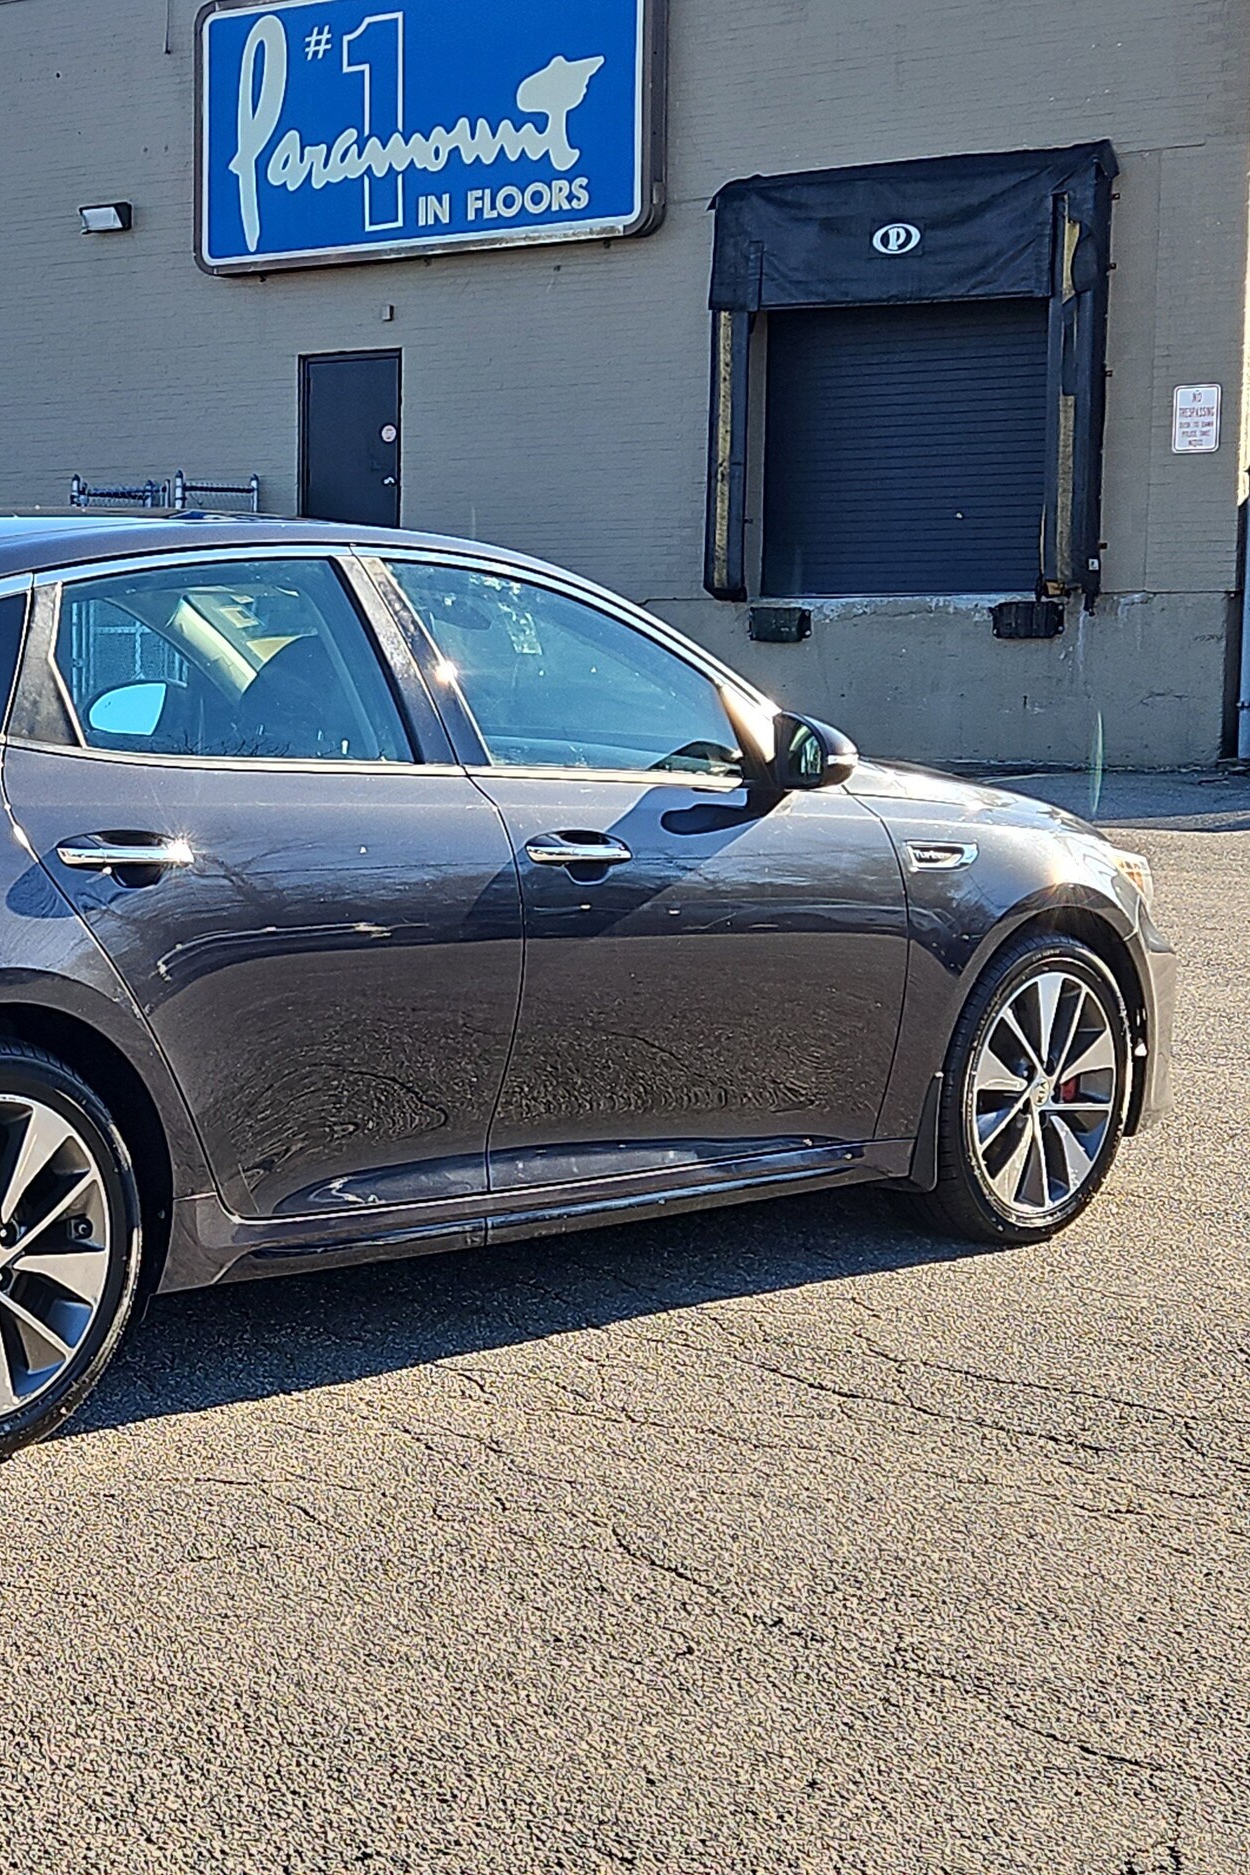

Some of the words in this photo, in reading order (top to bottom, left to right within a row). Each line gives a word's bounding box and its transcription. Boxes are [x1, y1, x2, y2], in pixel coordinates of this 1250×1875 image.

[418, 195, 450, 227] IN
[467, 177, 590, 221] FLOORS
[1192, 391, 1203, 403] NO
[1179, 406, 1215, 418] TRESPASSING
